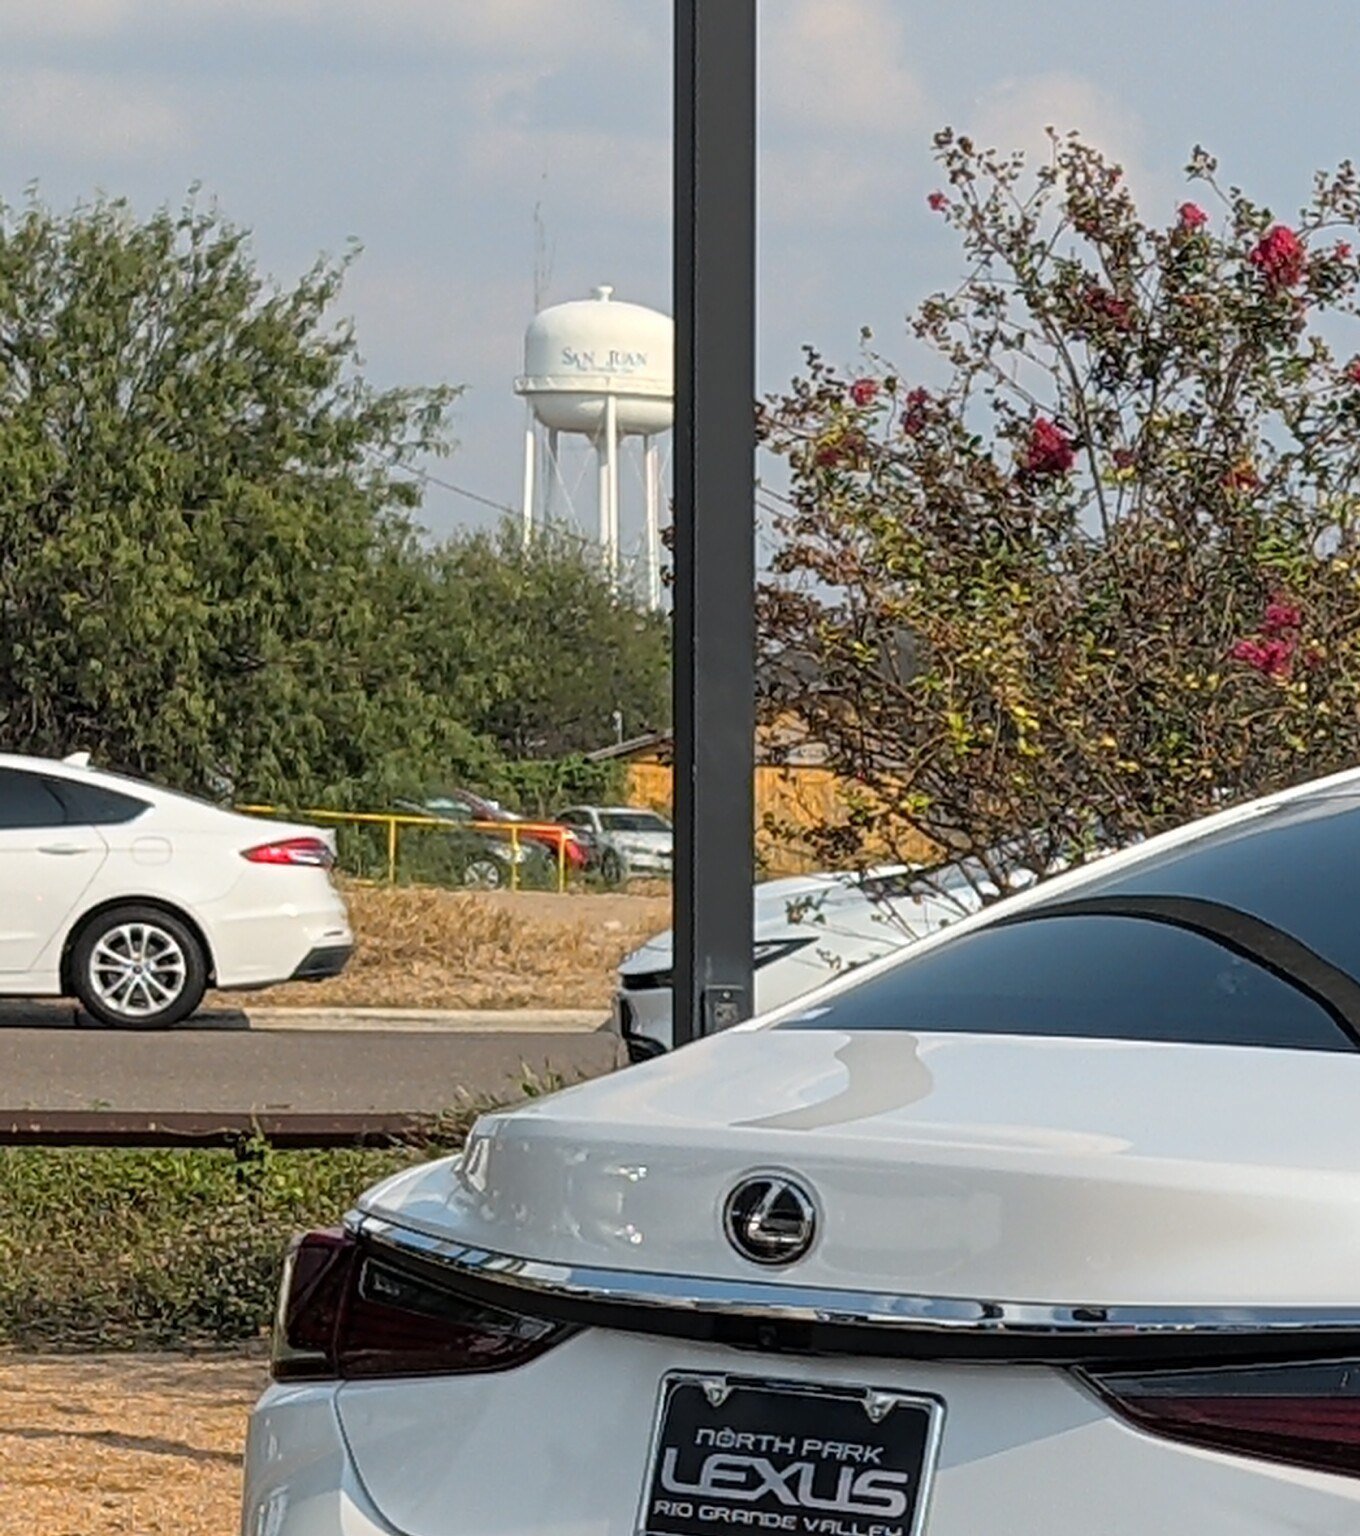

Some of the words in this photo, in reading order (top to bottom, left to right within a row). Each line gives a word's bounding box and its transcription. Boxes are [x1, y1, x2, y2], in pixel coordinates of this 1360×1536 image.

[695, 1428, 795, 1453] NORTH
[801, 1438, 884, 1464] PARK
[662, 1447, 908, 1517] LEXUS
[653, 1500, 693, 1517] RIO
[698, 1505, 797, 1530] GRANDE
